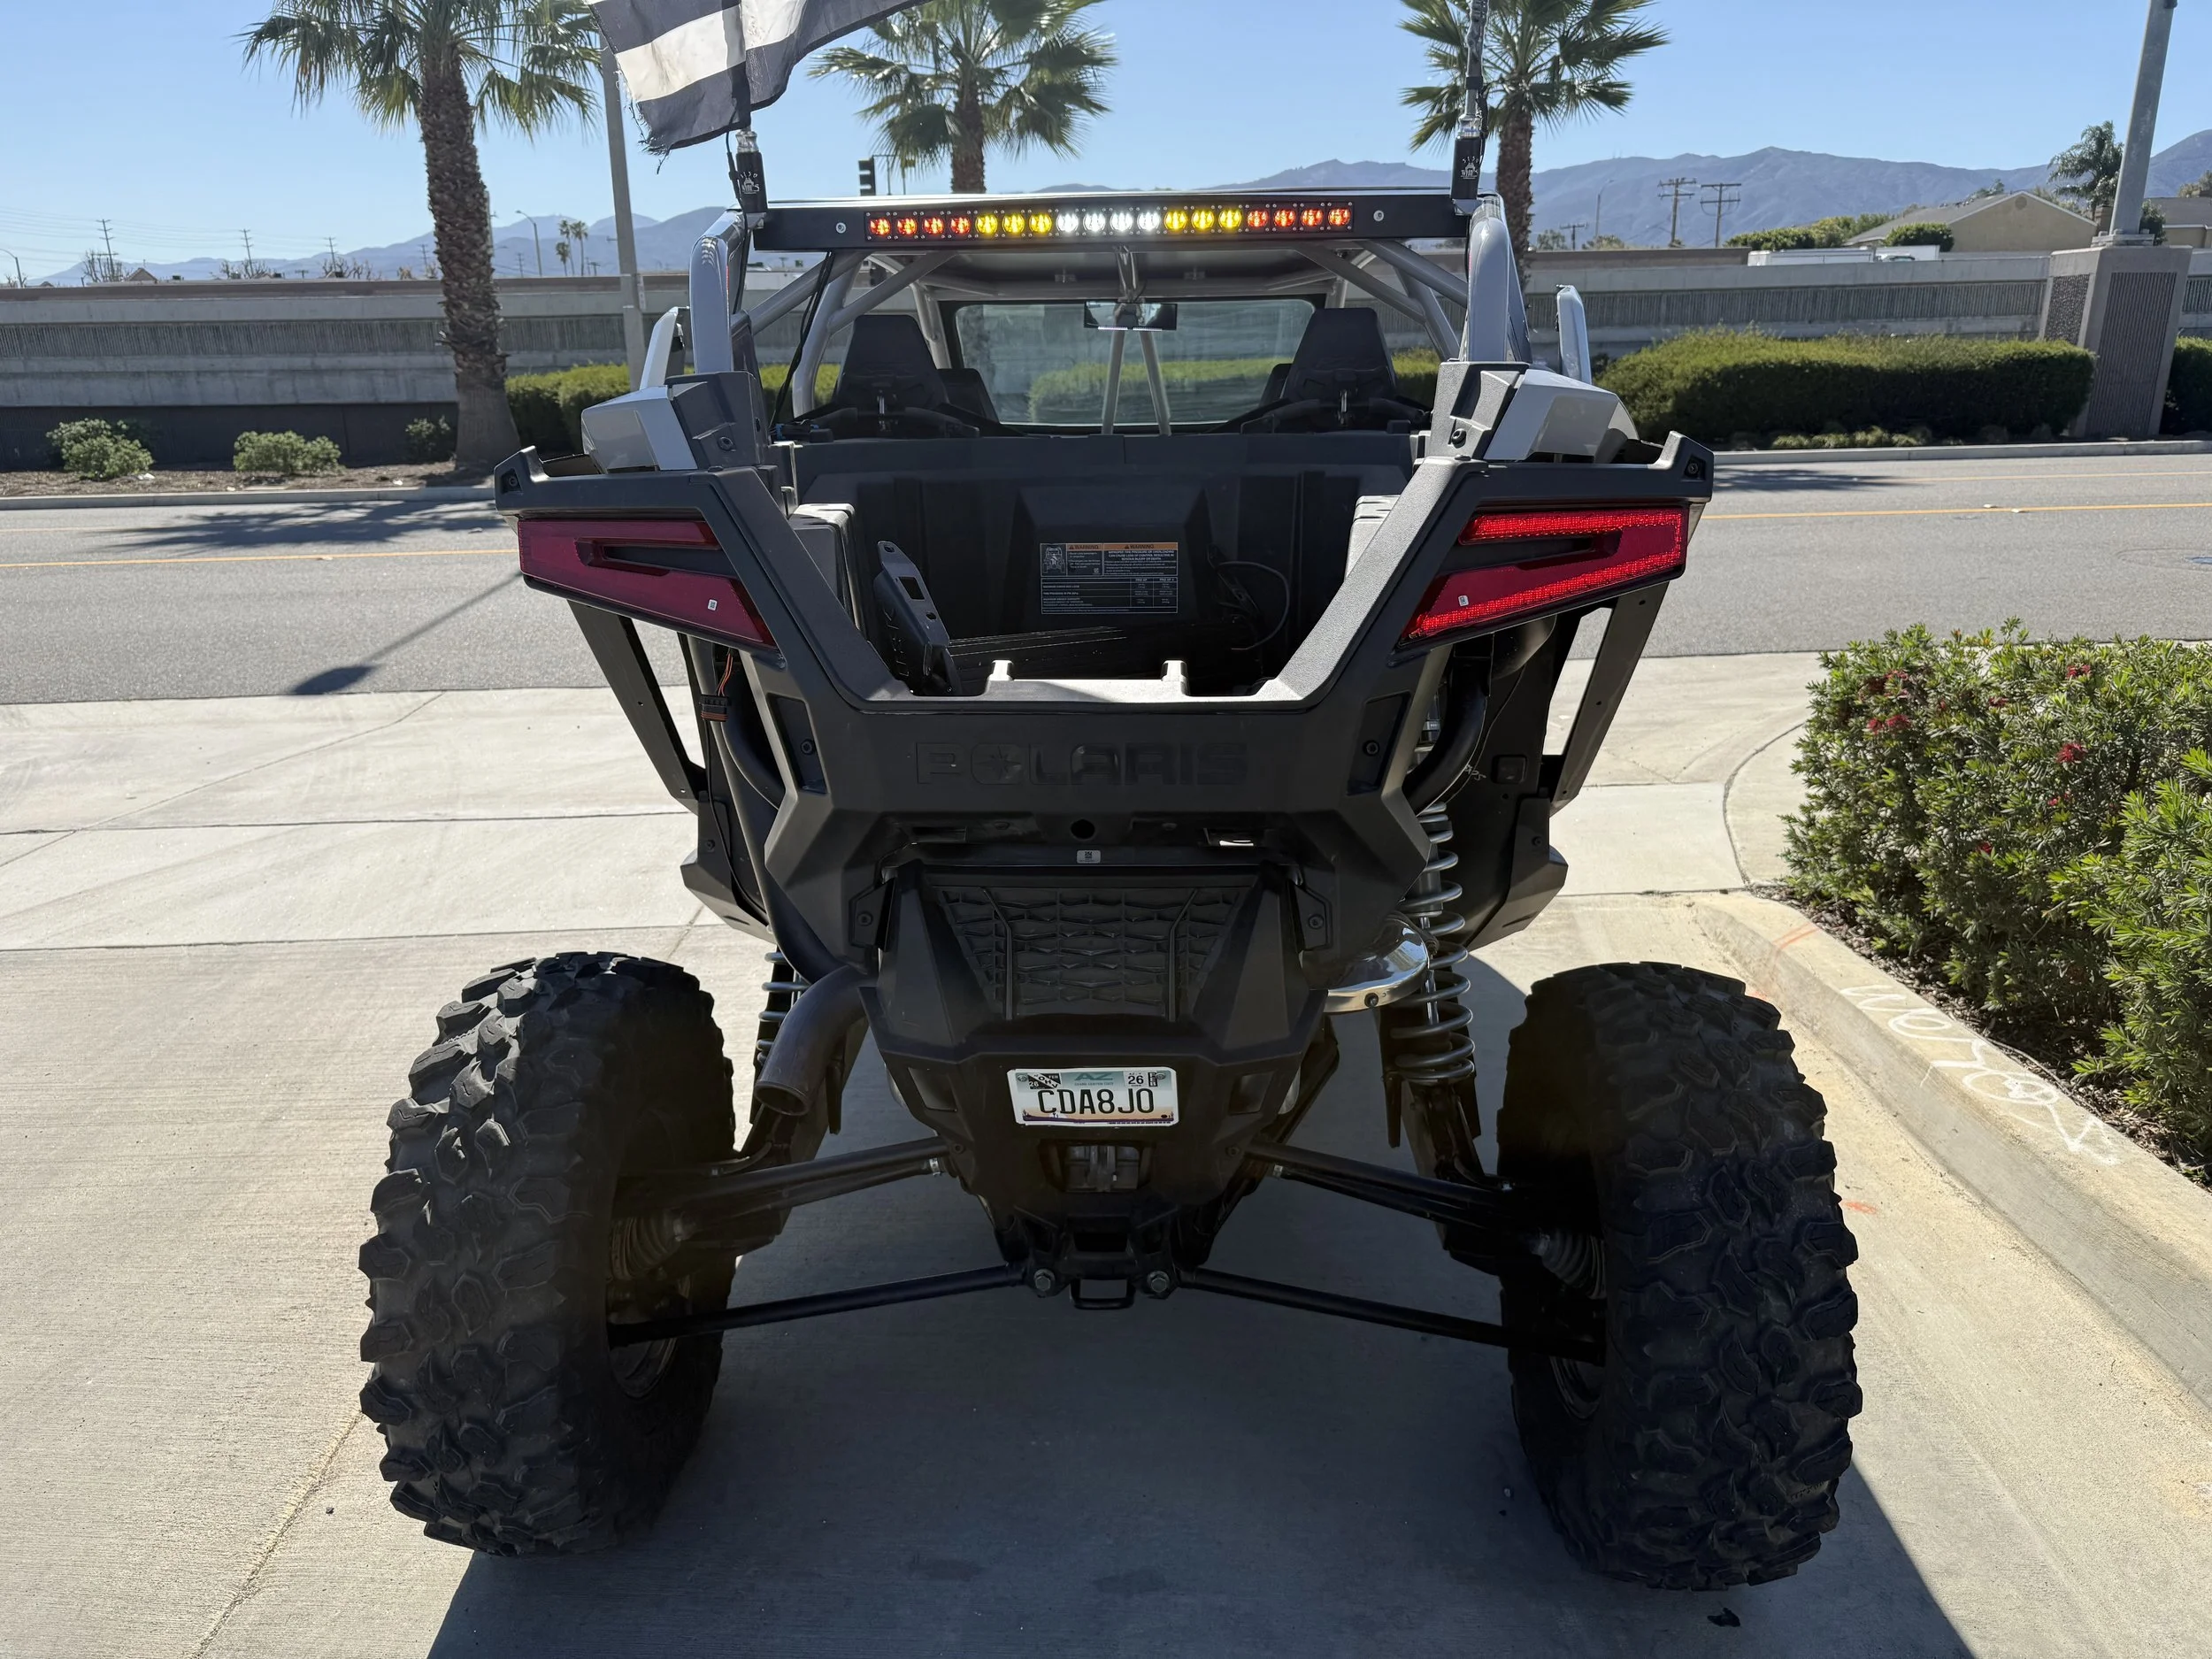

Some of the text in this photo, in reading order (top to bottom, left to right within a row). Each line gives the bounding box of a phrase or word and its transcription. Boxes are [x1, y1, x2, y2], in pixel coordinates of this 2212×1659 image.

[917, 742, 1248, 786] POLARIS
[1038, 1076, 1058, 1088] OHV
[1127, 1075, 1144, 1085] 26
